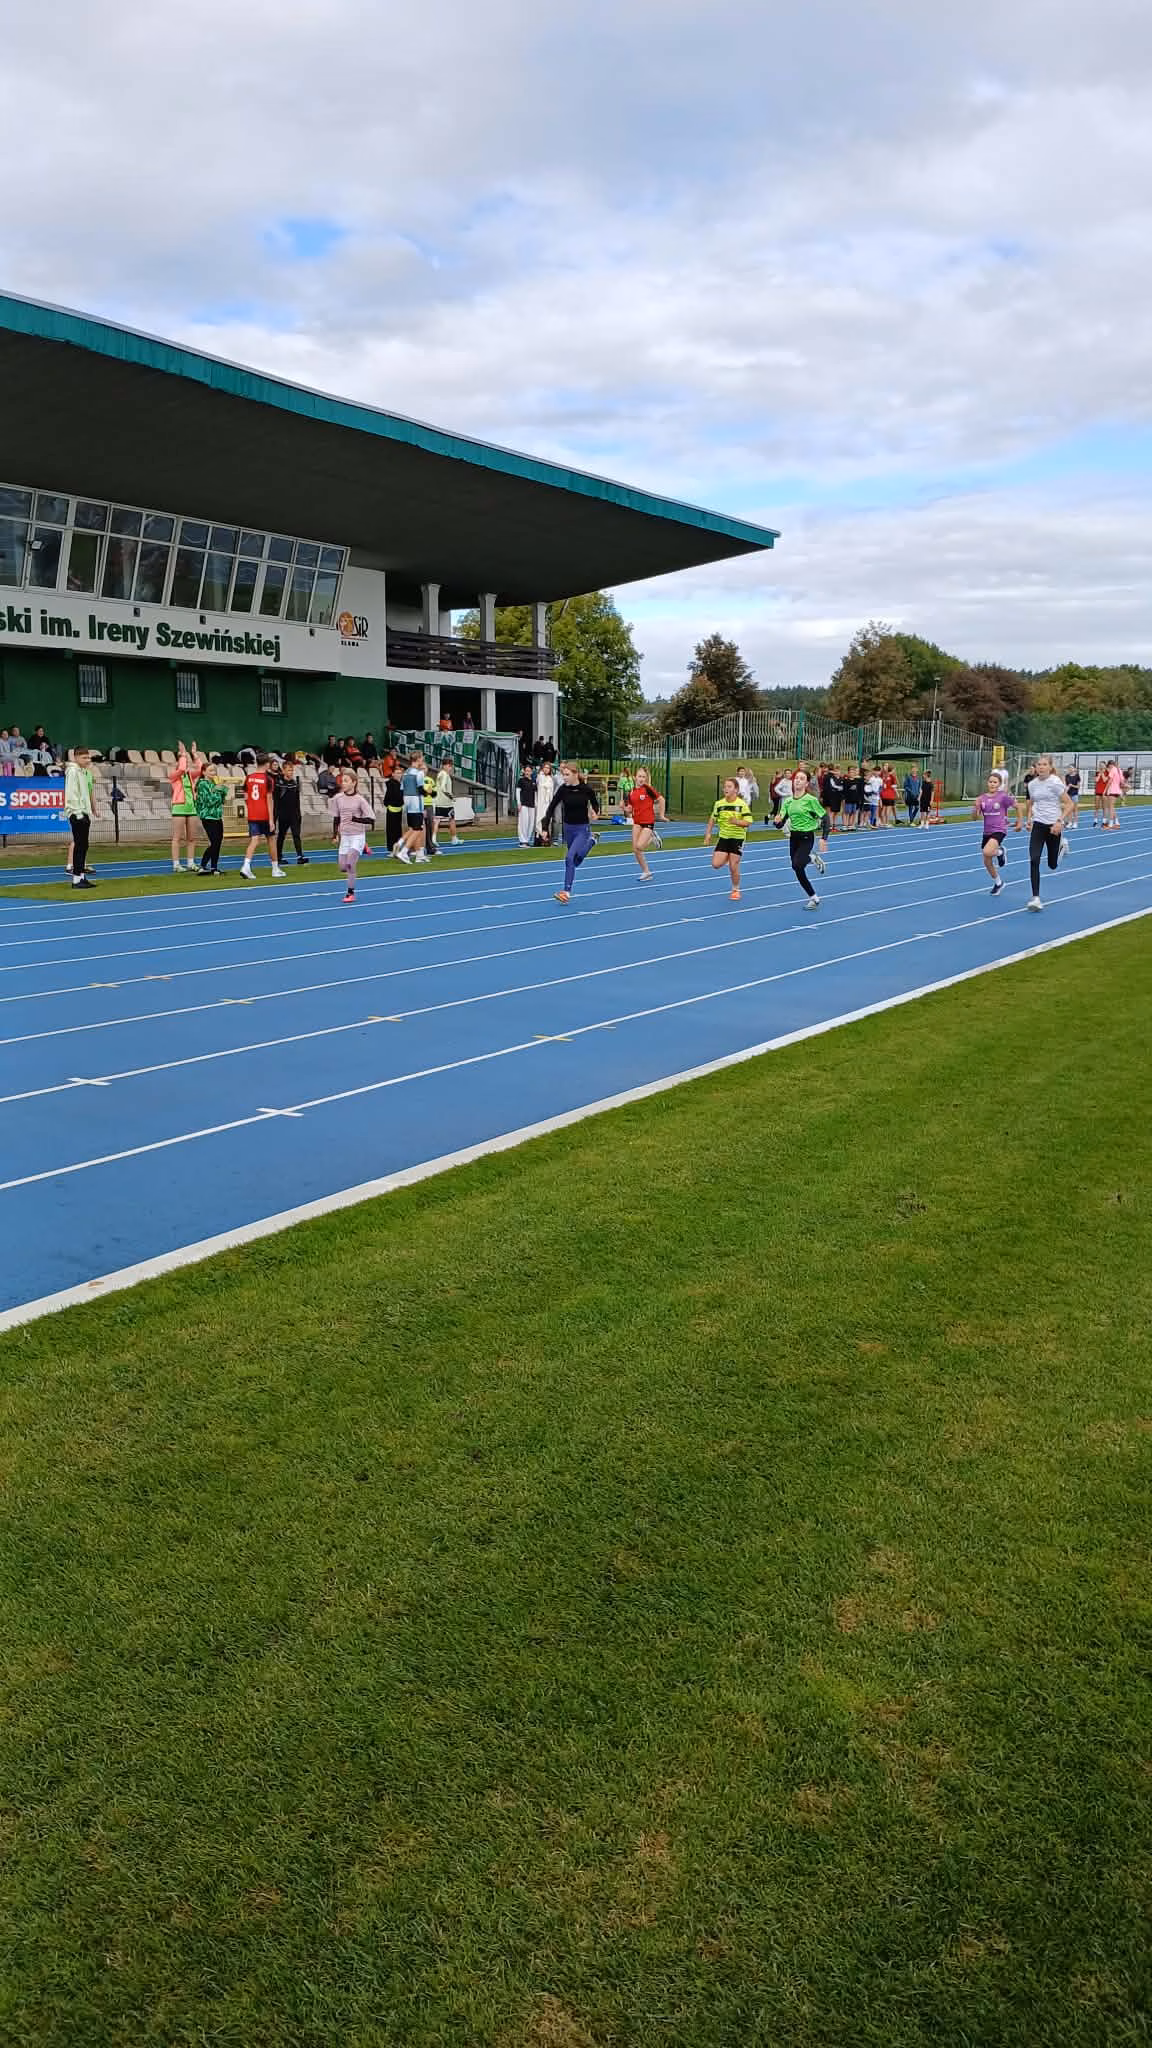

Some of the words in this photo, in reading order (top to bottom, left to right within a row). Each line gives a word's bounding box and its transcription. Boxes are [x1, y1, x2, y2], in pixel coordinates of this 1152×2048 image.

[40, 609, 80, 638] im.
[88, 614, 149, 650] Ireny
[156, 622, 280, 662] Szewińskiej
[10, 791, 63, 806] SPORT!
[251, 784, 260, 800] 8
